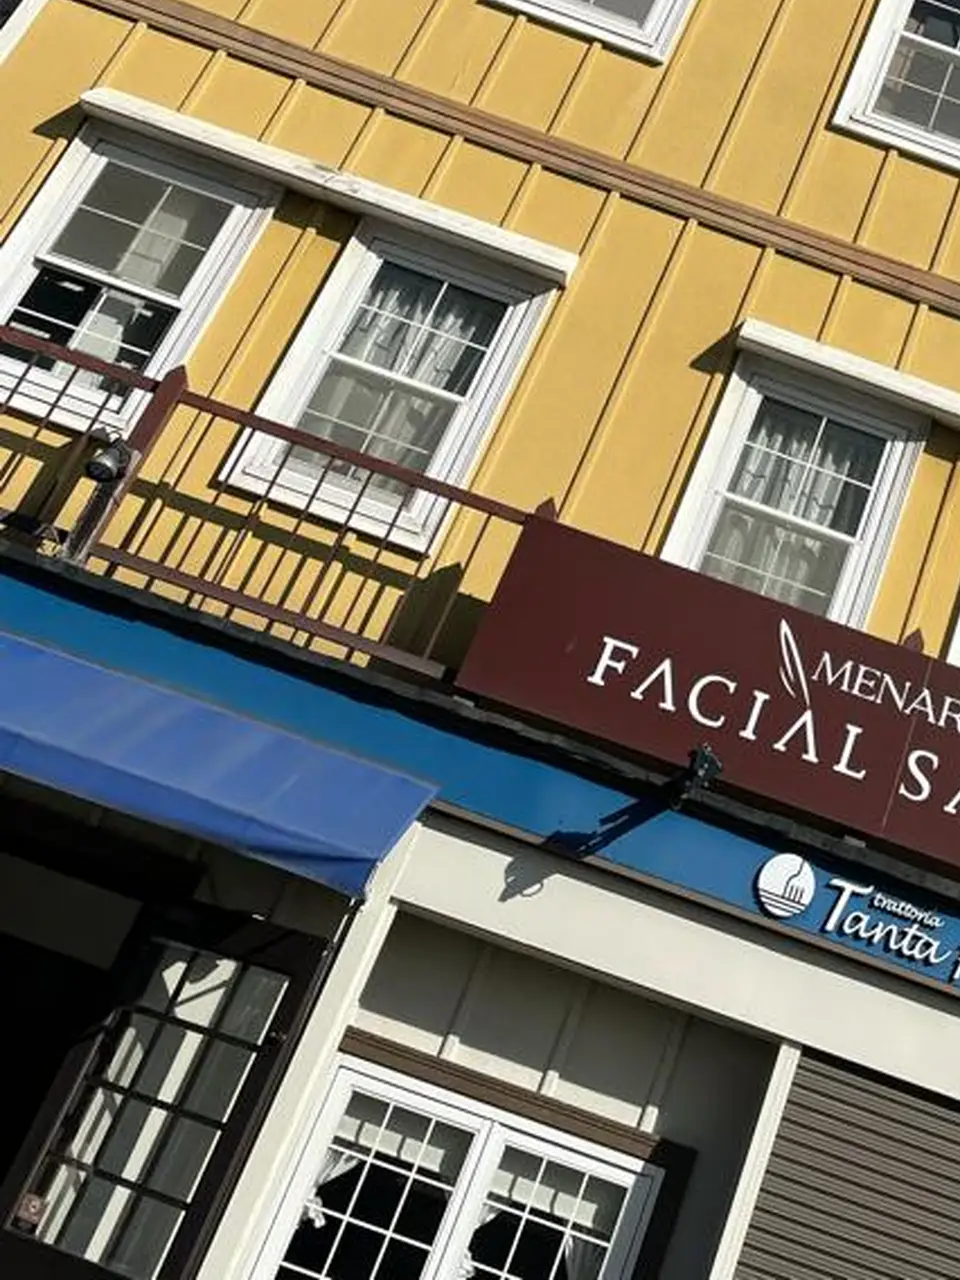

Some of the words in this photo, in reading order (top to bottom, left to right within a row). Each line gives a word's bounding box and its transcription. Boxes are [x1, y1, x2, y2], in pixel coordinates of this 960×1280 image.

[587, 636, 867, 780] FACIAL
[825, 878, 953, 964] Tanta
[873, 892, 946, 928] trattoria
